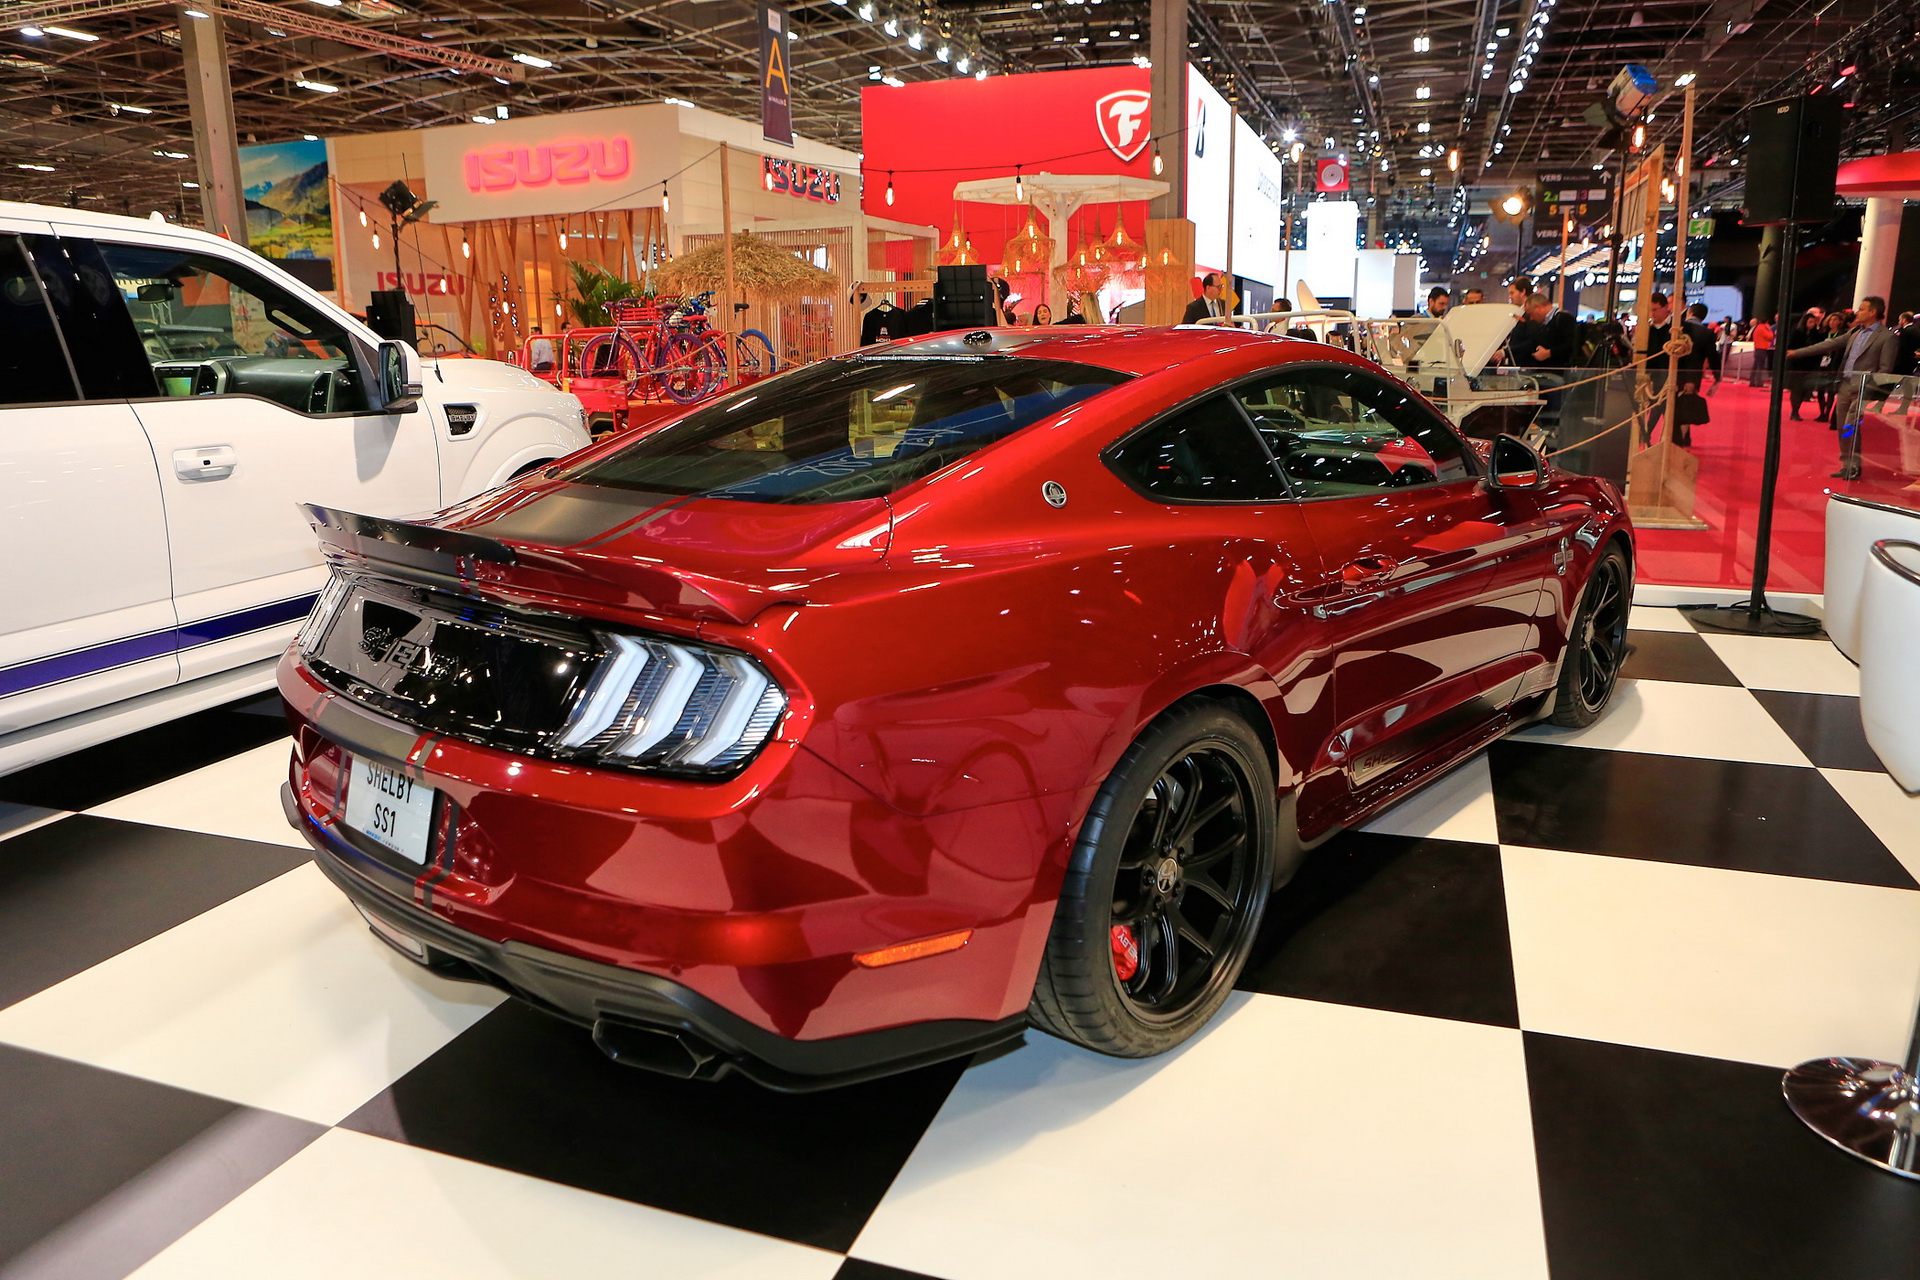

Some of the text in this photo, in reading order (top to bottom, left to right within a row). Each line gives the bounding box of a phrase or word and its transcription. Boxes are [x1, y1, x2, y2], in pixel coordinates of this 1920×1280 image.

[766, 37, 788, 95] A
[465, 138, 628, 192] ISUZU
[761, 153, 840, 204] ISUZU
[1540, 173, 1562, 182] VERS
[1536, 229, 1557, 238] VERS
[377, 271, 465, 296] ISUZU
[1596, 274, 1639, 284] REAULT
[450, 414, 475, 422] SHELBY
[367, 761, 414, 803] SHELBY
[374, 803, 396, 837] SS1
